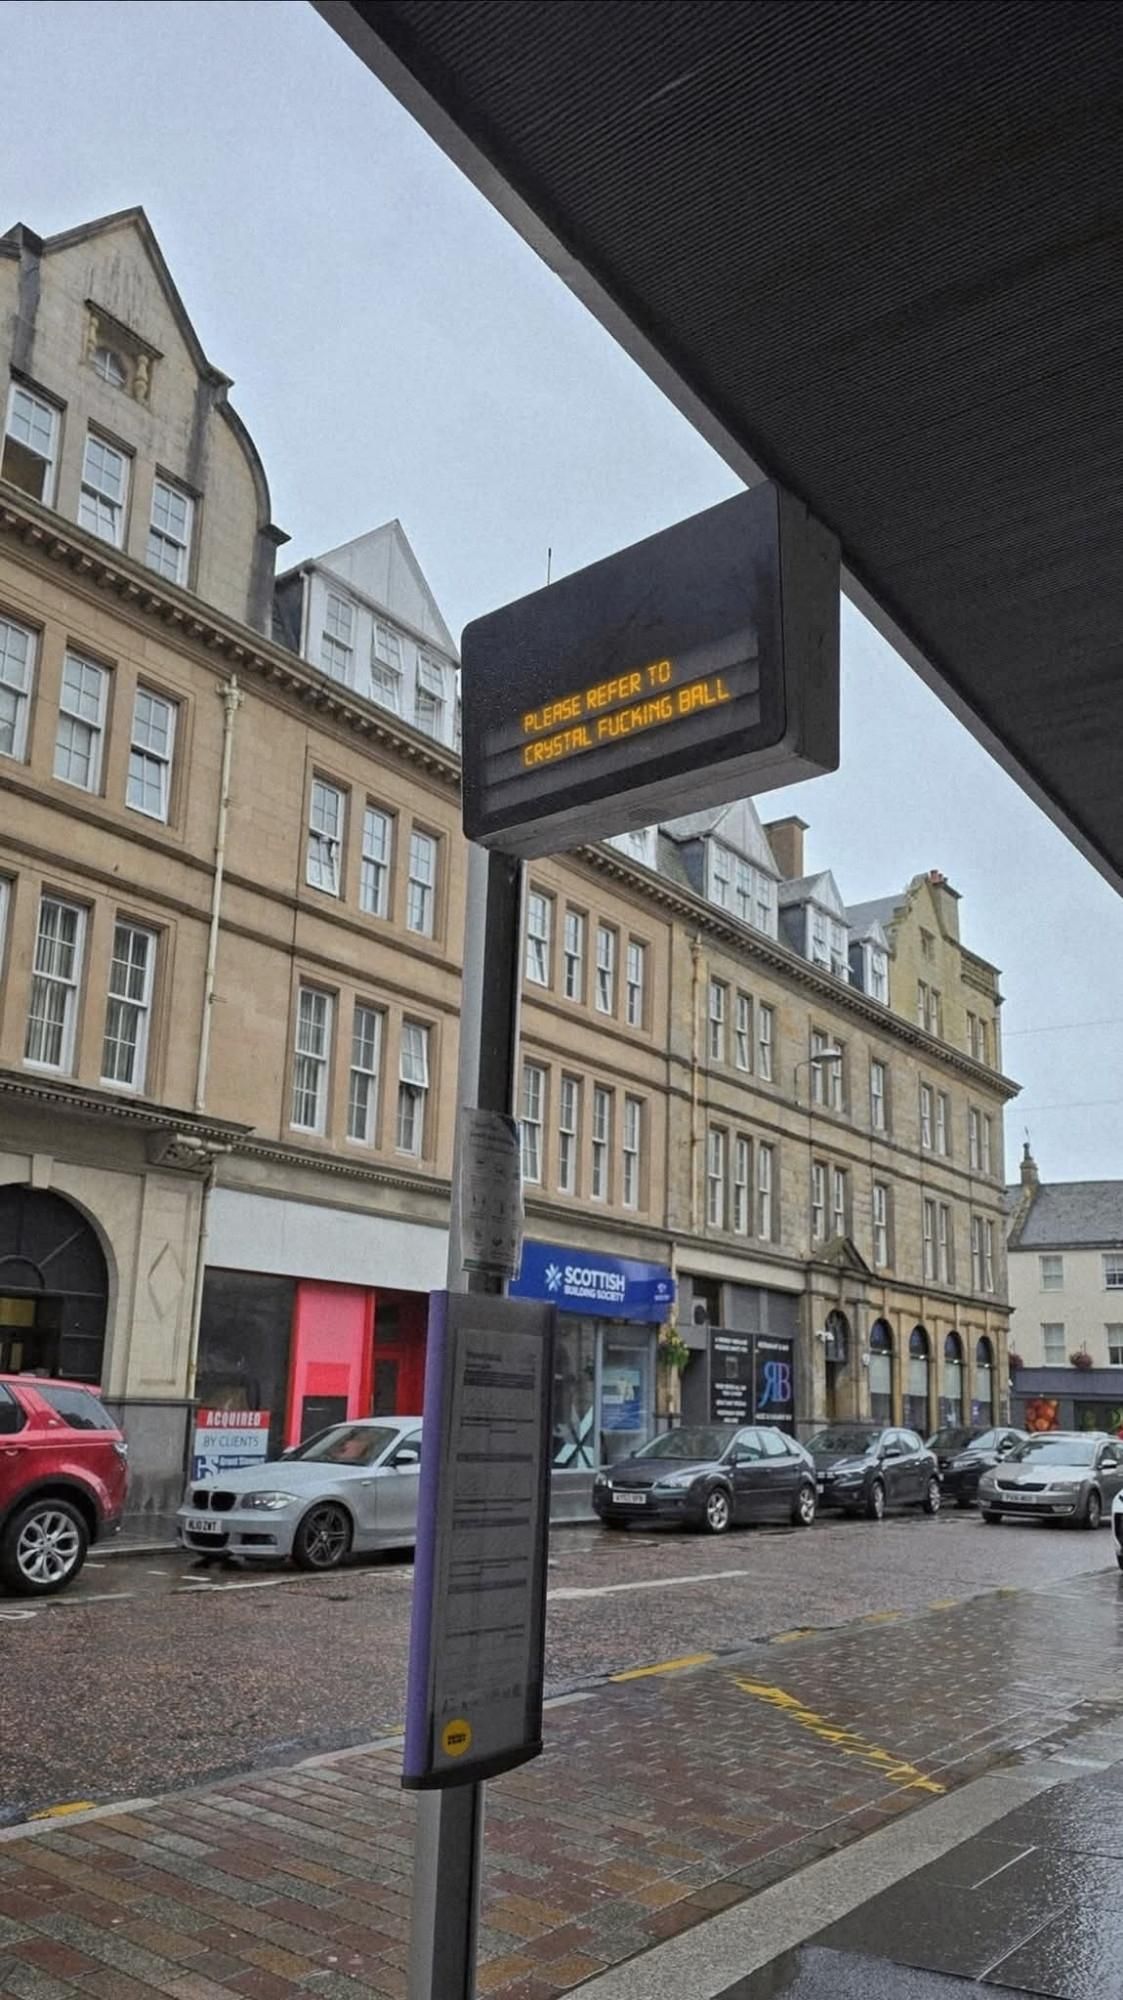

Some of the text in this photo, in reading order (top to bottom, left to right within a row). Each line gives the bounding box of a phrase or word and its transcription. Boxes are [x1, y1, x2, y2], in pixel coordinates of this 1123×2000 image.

[523, 660, 671, 732] PLEASE REFER TO
[523, 679, 729, 766] CRYSTAL FUCKING BALL
[564, 1266, 625, 1292] SCOTTISH
[564, 1285, 625, 1302] BUILDING SOCIETY
[206, 1411, 261, 1428] ACQUIRED
[203, 1436, 259, 1448] BY CLIENTS
